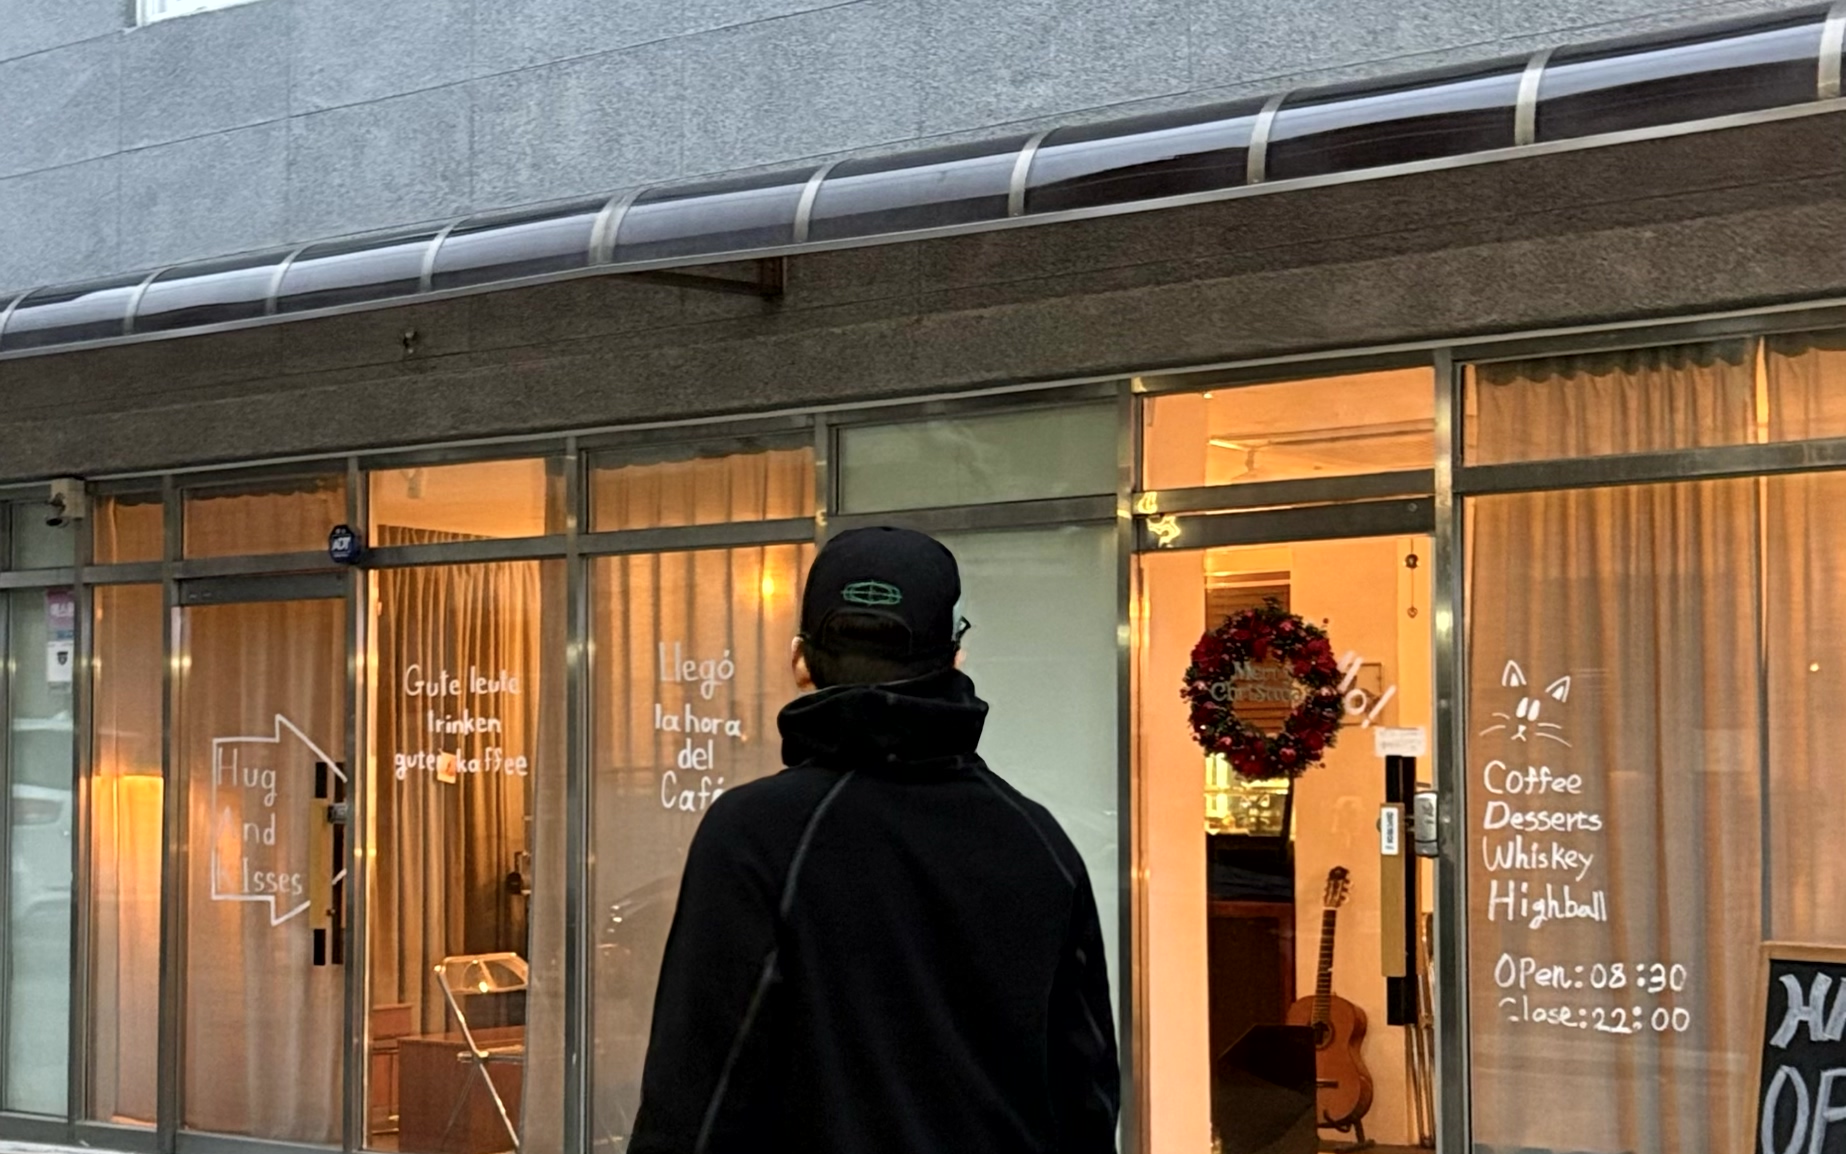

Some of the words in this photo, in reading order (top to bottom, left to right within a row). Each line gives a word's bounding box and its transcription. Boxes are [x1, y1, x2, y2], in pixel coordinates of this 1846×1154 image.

[331, 536, 351, 551] ADT
[405, 663, 462, 697] Gute
[658, 641, 735, 700] Llegó
[395, 749, 447, 781] gute
[677, 737, 714, 771] del
[216, 746, 278, 808] Hug
[1483, 759, 1583, 795] Coffee
[1483, 800, 1603, 832] Desserts
[1482, 834, 1594, 882] Whiskey
[1487, 879, 1608, 930] Highball
